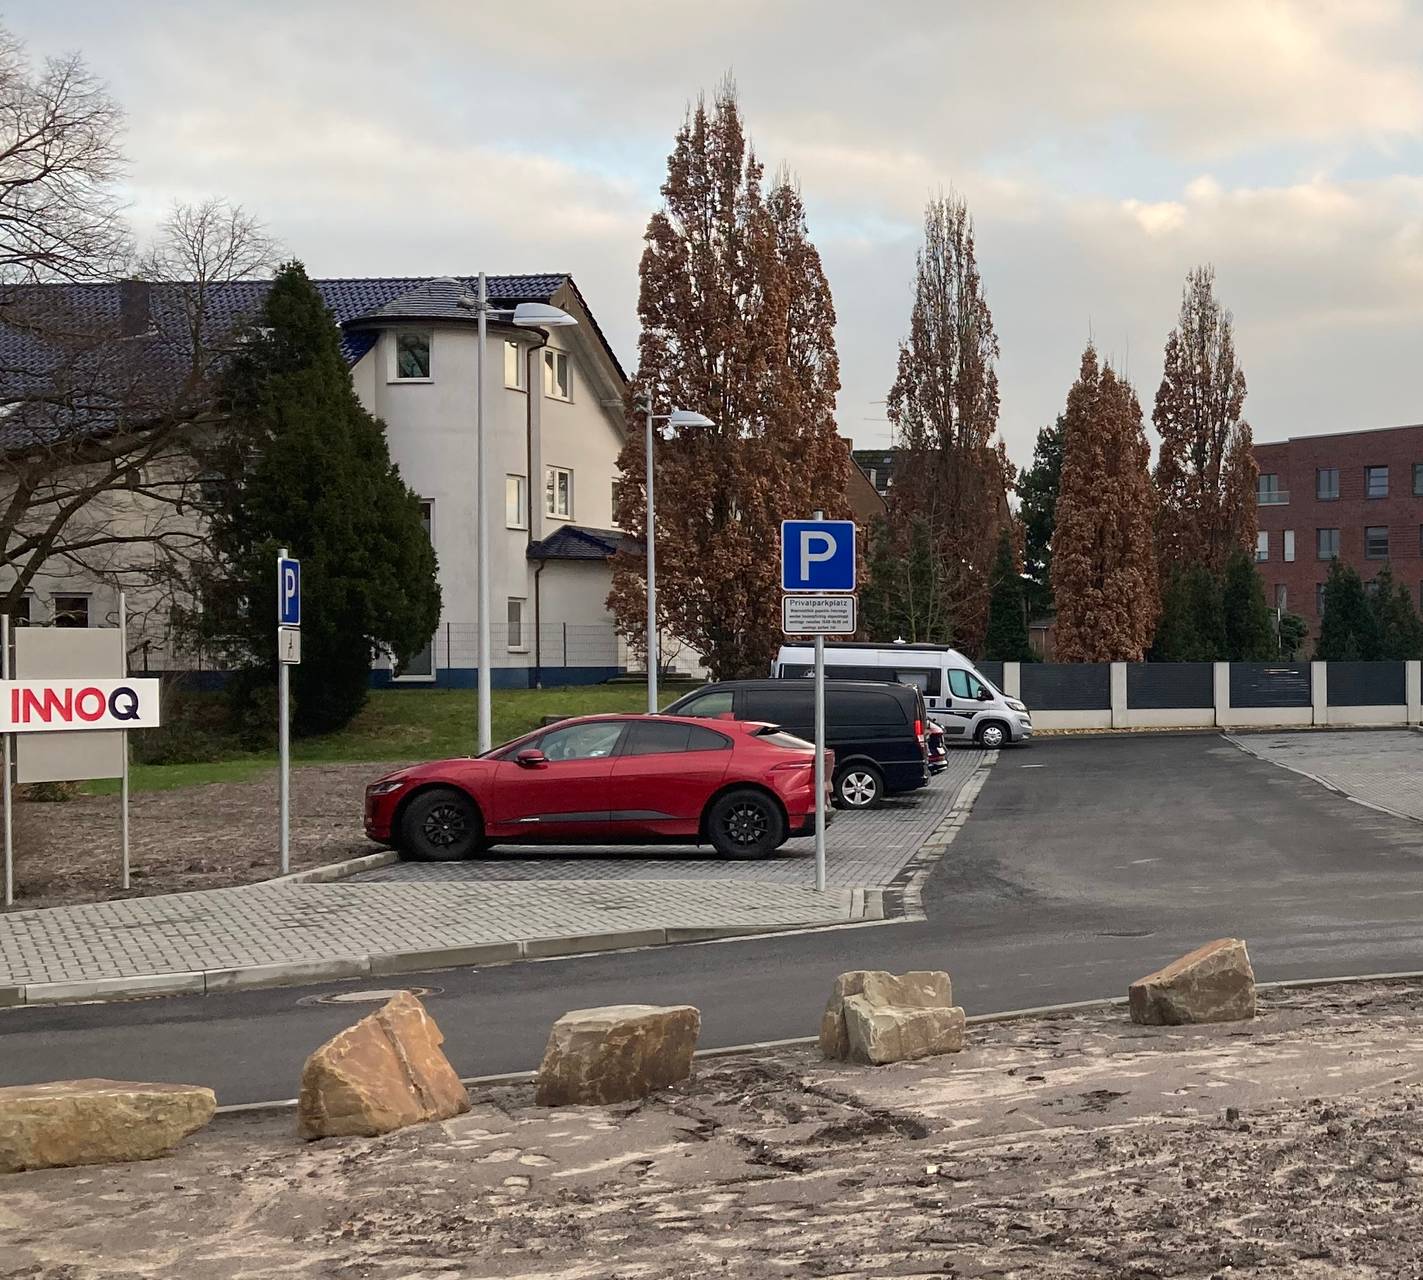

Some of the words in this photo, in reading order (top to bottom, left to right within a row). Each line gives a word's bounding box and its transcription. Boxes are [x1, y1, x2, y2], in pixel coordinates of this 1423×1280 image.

[800, 531, 837, 581] P
[285, 568, 296, 615] P
[790, 599, 848, 607] Privatparkplatz
[11, 687, 141, 723] INNOQ
